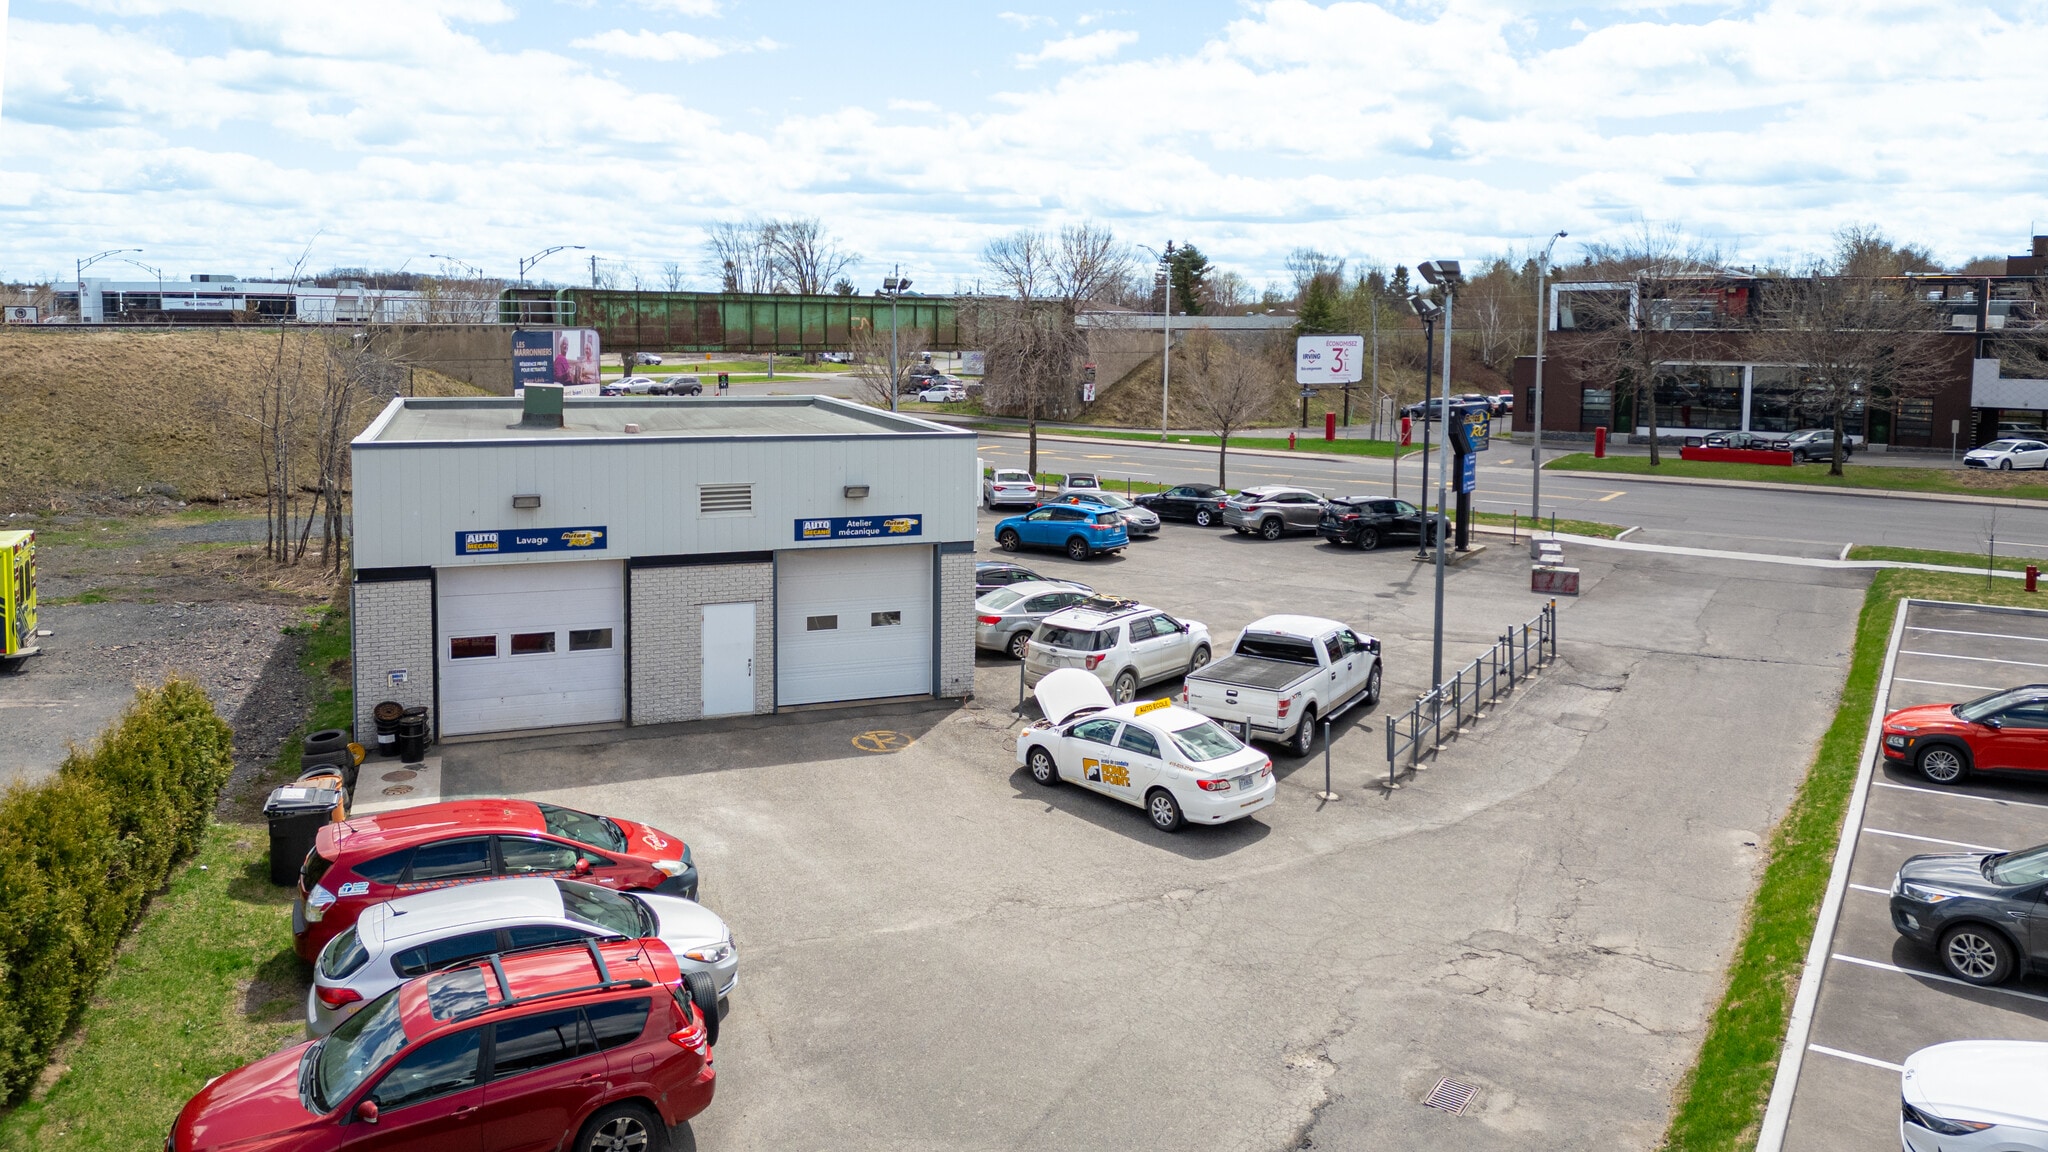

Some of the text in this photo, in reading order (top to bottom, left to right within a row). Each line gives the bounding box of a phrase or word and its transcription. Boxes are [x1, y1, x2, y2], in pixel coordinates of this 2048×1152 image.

[514, 348, 552, 357] MARRONNIERS
[1331, 348, 1344, 373] 3
[1470, 423, 1488, 438] RG
[804, 520, 830, 530] AUTO
[847, 520, 872, 528] Atelier
[839, 527, 880, 537] mécanique
[467, 533, 497, 543] AUTO
[516, 536, 549, 546] Lavage
[1140, 704, 1153, 712] AUTO
